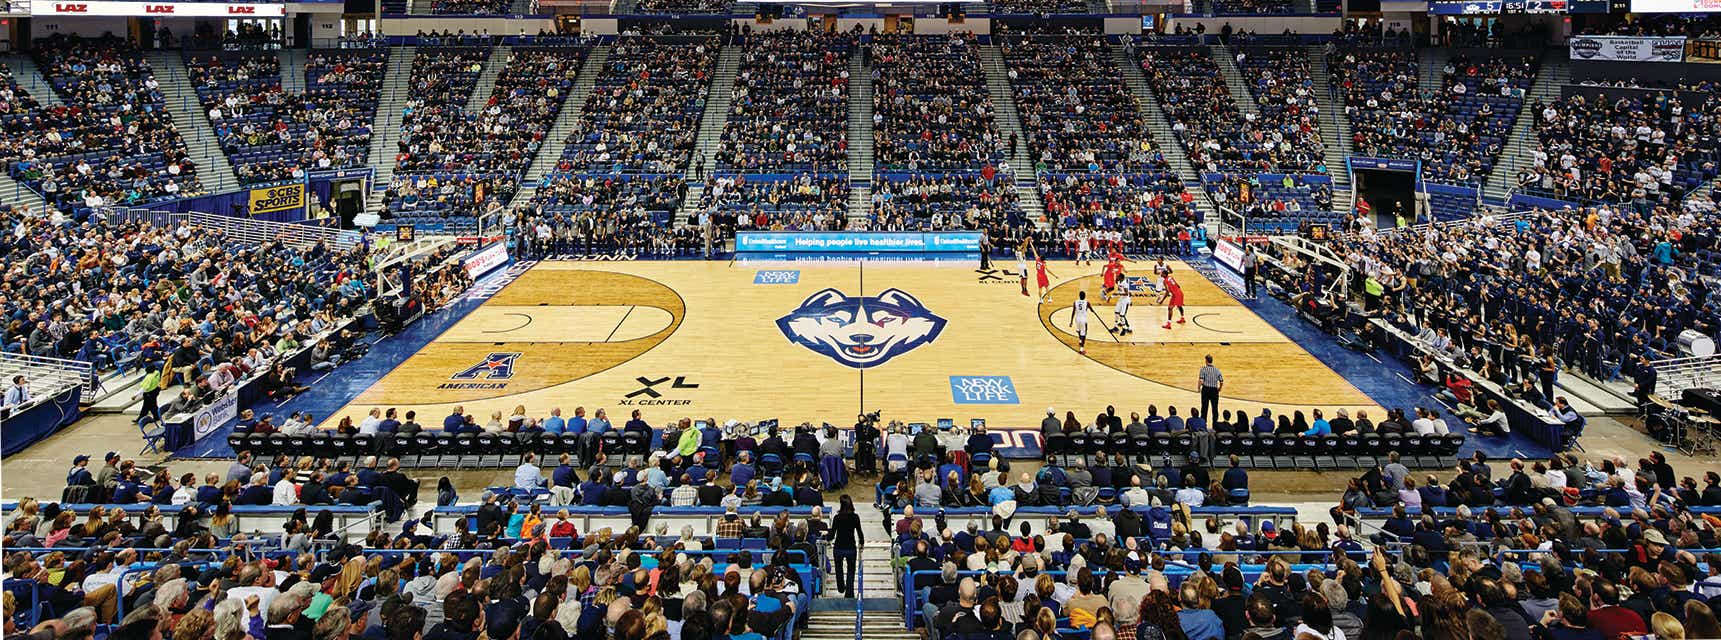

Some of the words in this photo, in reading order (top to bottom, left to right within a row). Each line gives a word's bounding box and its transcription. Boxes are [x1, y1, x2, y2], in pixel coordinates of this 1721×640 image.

[56, 4, 87, 12] LAZ
[146, 5, 174, 13] LAZ
[228, 6, 255, 14] LAZ
[1487, 1, 1494, 10] 5
[1534, 1, 1542, 10] 2
[277, 186, 301, 197] CBS
[254, 195, 300, 212] SPORTS
[795, 238, 824, 247] Helping
[826, 239, 852, 247] people
[854, 238, 868, 246] live
[869, 238, 903, 246] healthier
[960, 378, 1004, 387] NEW
[624, 376, 700, 399] XL
[954, 384, 1013, 394] YORK
[964, 392, 1009, 401] LIFE
[211, 396, 238, 416] Webster
